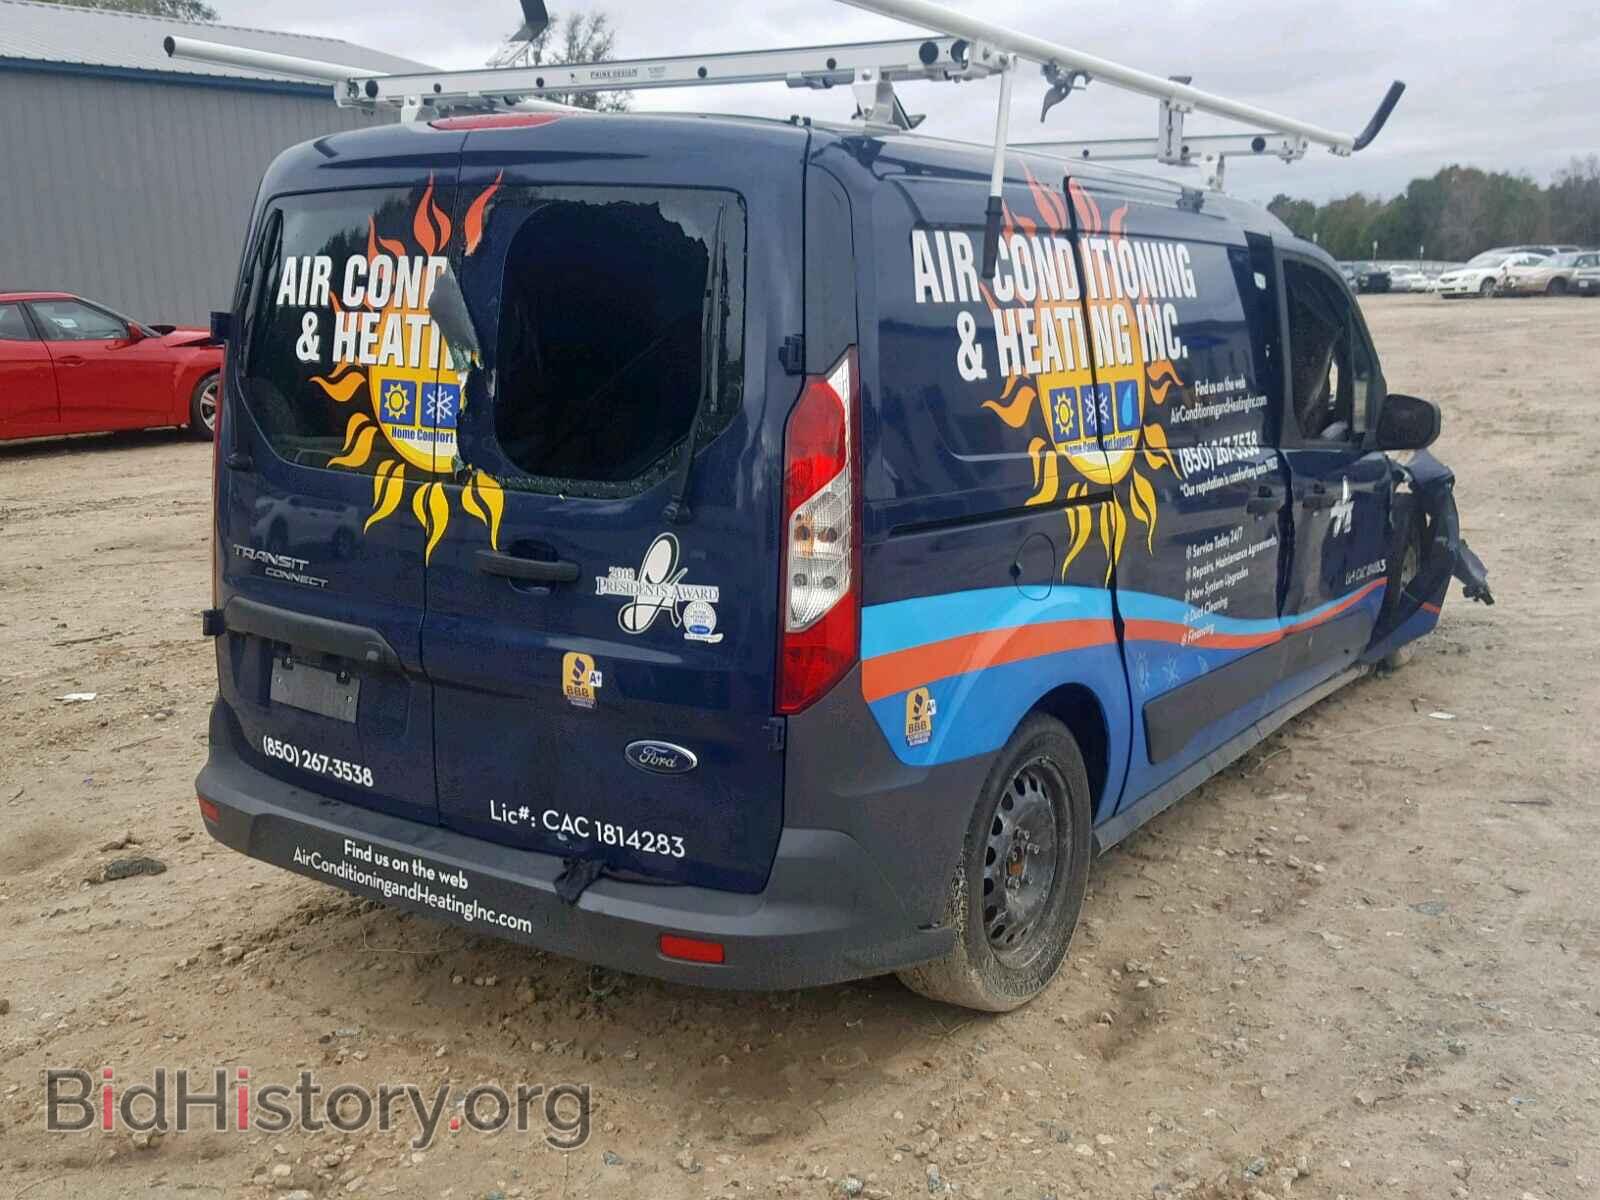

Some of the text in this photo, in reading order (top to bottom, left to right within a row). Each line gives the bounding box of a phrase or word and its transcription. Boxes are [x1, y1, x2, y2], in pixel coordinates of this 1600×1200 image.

[276, 256, 332, 305] AIR
[912, 230, 981, 302] AIR
[296, 311, 320, 361] &
[956, 303, 1187, 381] & HEATING INC.
[1195, 379, 1208, 396] Find
[392, 426, 415, 440] Home
[1179, 430, 1260, 479] (850) 267-3538
[233, 544, 309, 571] TRANSIT
[1193, 541, 1214, 558] Service
[265, 567, 328, 588] CONNECT
[672, 584, 718, 602] AWARD
[566, 685, 590, 698] BBB
[590, 671, 601, 685] A+
[263, 735, 374, 787] (850) 267-3538
[638, 746, 678, 768] Ford
[490, 800, 686, 858] Lic#: CAC 1814283
[344, 839, 469, 889] Find us on the web
[293, 847, 532, 934] AirConditioningandHeatingInc.com
